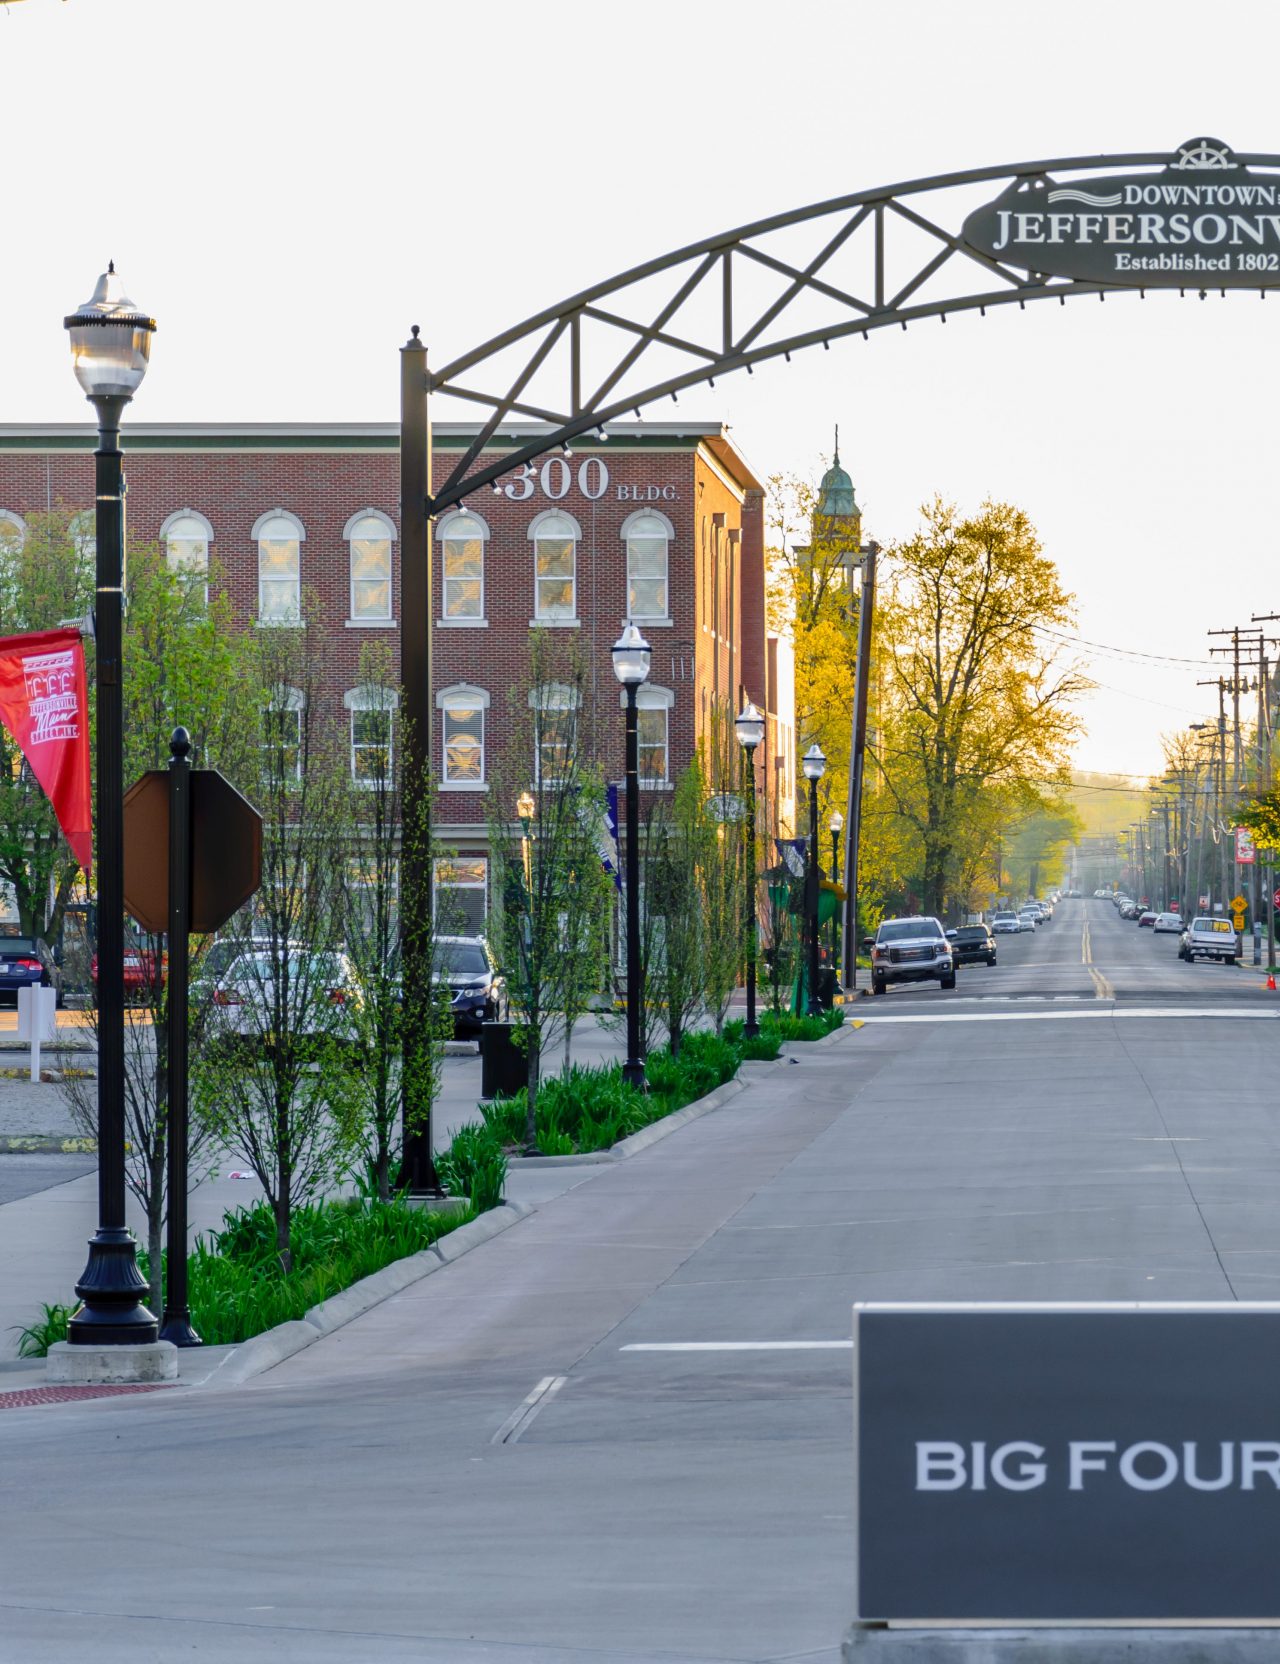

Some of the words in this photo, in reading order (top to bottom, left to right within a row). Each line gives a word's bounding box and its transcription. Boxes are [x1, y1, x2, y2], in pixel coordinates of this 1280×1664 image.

[1124, 185, 1276, 206] DOWNTOWN
[1115, 253, 1230, 271] Established
[1236, 253, 1279, 271] 1802
[504, 457, 609, 500] 300
[617, 485, 681, 501] BLDG.
[915, 1440, 1048, 1491] BIG
